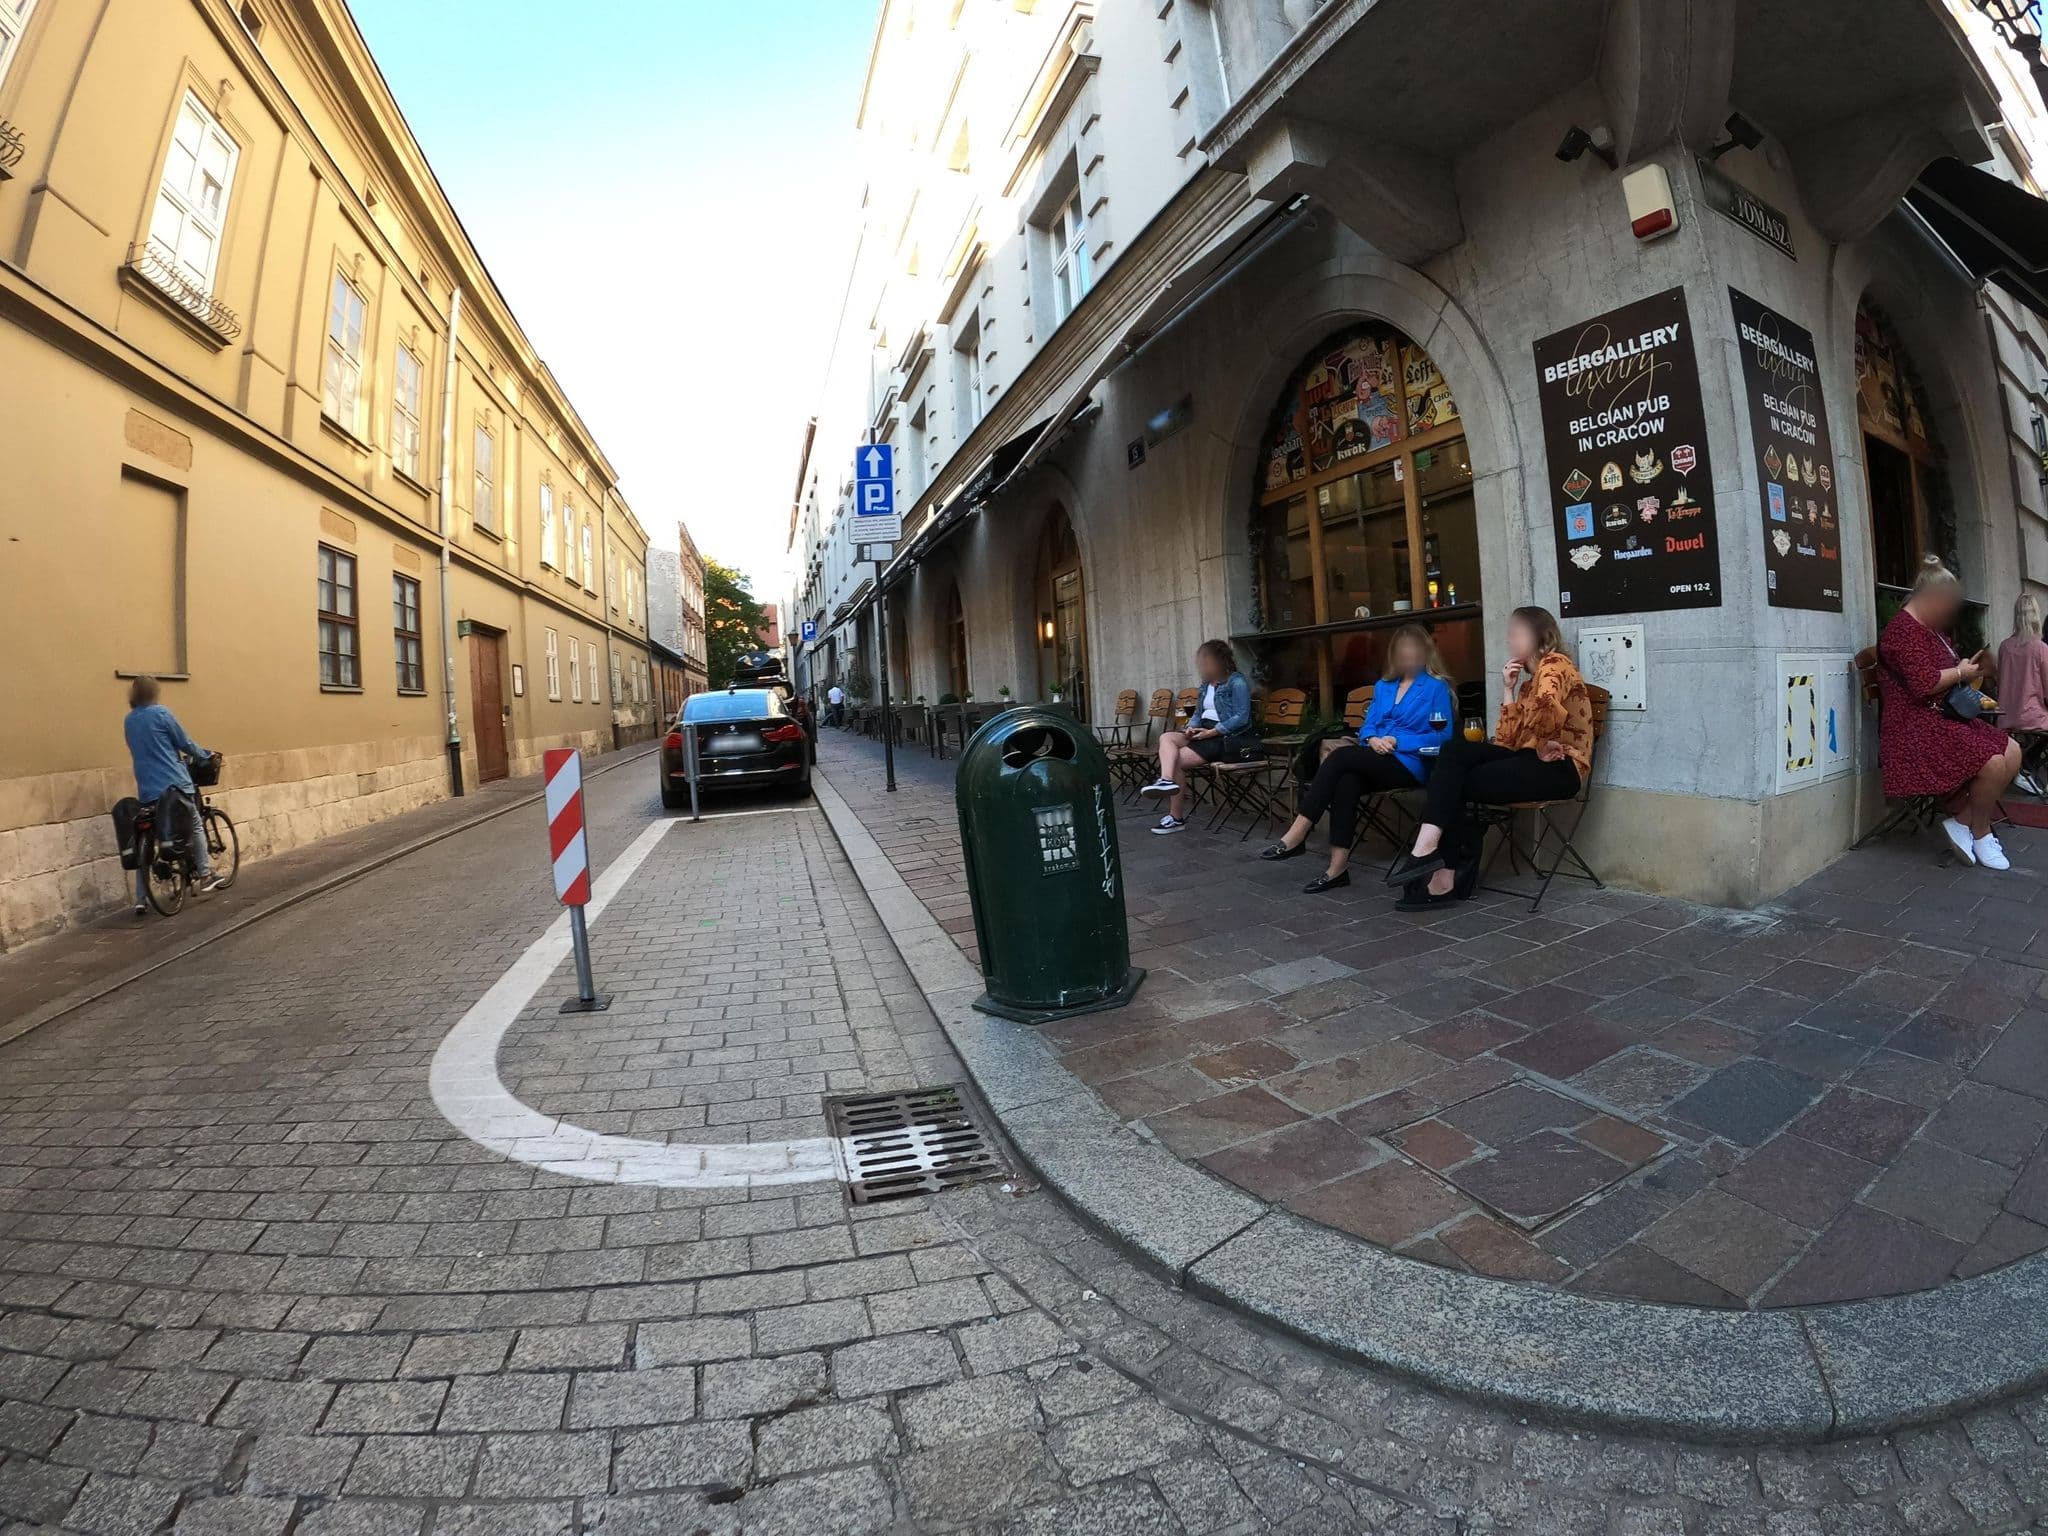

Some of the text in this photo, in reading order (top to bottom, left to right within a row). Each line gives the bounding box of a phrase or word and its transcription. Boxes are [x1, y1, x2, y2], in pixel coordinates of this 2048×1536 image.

[1544, 322, 1680, 384] BEERGALLERY
[1741, 323, 1814, 374] BEERGALLERY
[1569, 394, 1671, 436] BELGIAN PUB
[1763, 393, 1817, 428] BELGIAN PUB
[1578, 416, 1666, 453] IN CRACOW
[1770, 415, 1816, 447] IN CRACOW
[864, 483, 885, 512] P
[1665, 532, 1705, 553] Duvel
[1669, 582, 1711, 594] OPEN 12-2
